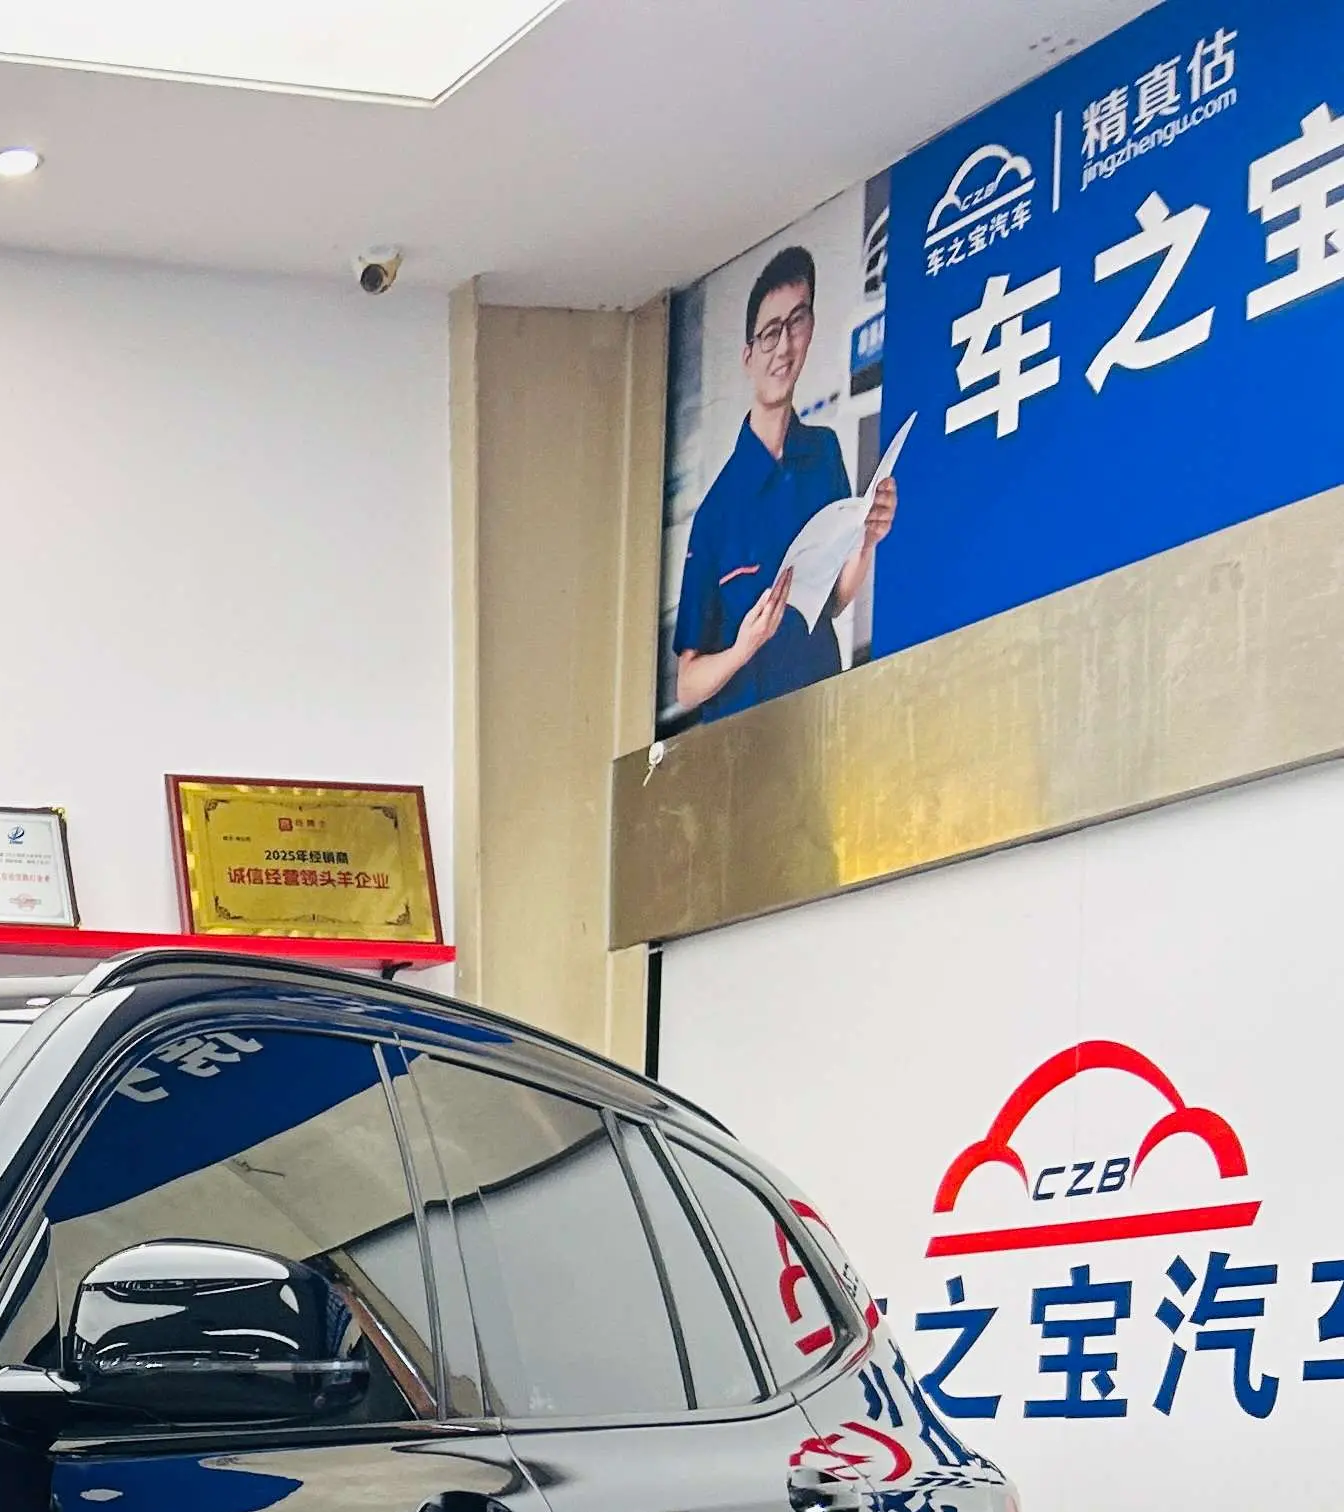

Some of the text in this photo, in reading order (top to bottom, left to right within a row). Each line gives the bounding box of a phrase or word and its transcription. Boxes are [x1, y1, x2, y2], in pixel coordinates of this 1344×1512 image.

[1081, 27, 1238, 159] 精真估
[1079, 88, 1237, 192] jingzhengu.com
[925, 200, 1032, 276] 车之宝汽车
[228, 867, 390, 890] 诚信经营领头羊企业
[1032, 1156, 1132, 1201] CZB
[874, 1250, 1344, 1420] 之宝汽
